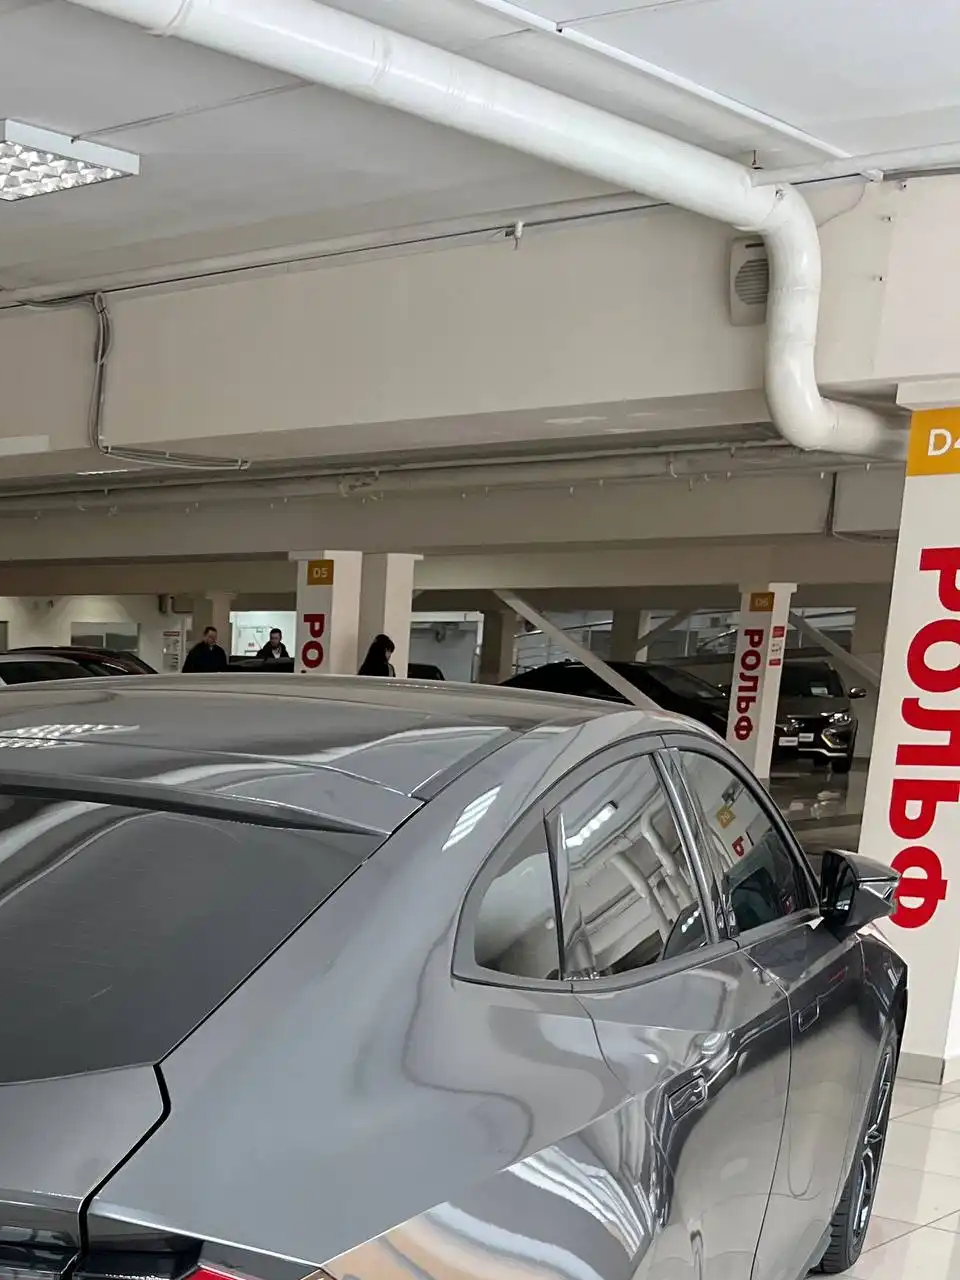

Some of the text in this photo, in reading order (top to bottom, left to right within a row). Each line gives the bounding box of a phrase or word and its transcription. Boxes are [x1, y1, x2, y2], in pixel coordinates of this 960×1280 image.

[312, 567, 329, 579] D5
[301, 613, 325, 674] РО
[734, 629, 764, 741] РОЛЬФ
